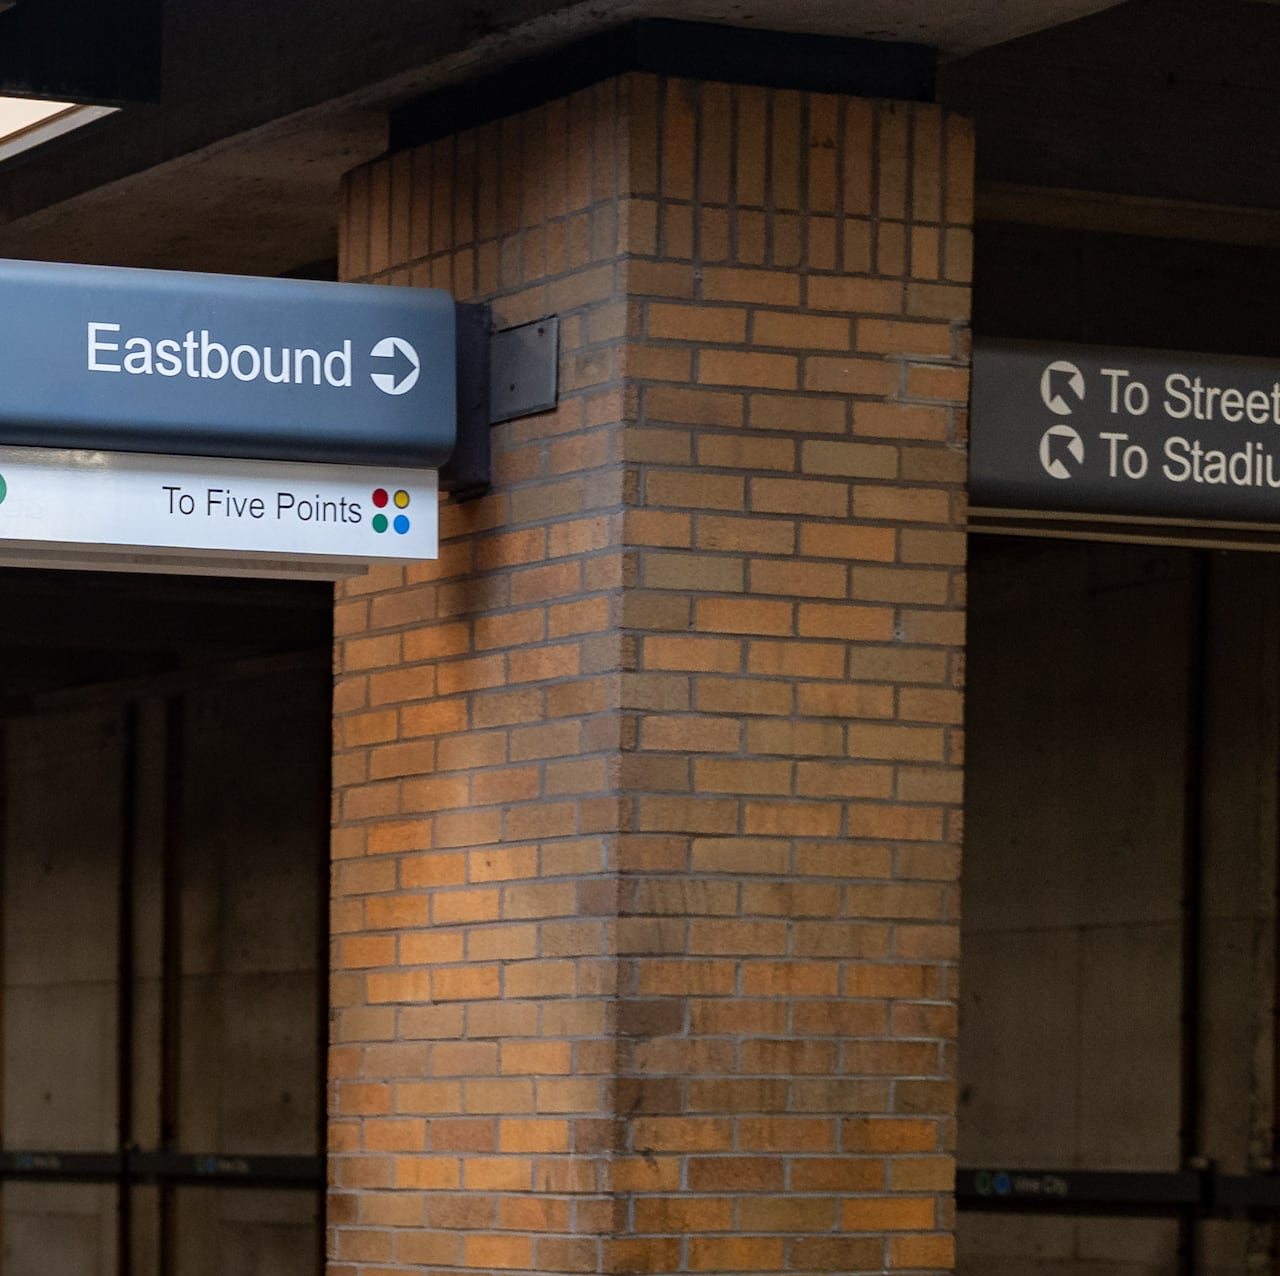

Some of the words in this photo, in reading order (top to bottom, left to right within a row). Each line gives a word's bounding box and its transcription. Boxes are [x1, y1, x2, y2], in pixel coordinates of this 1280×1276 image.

[88, 322, 351, 386] Eastbound
[1101, 369, 1148, 415] To
[1100, 433, 1148, 479] To
[162, 487, 194, 514] To
[208, 489, 264, 518] Five
[278, 493, 361, 523] Points
